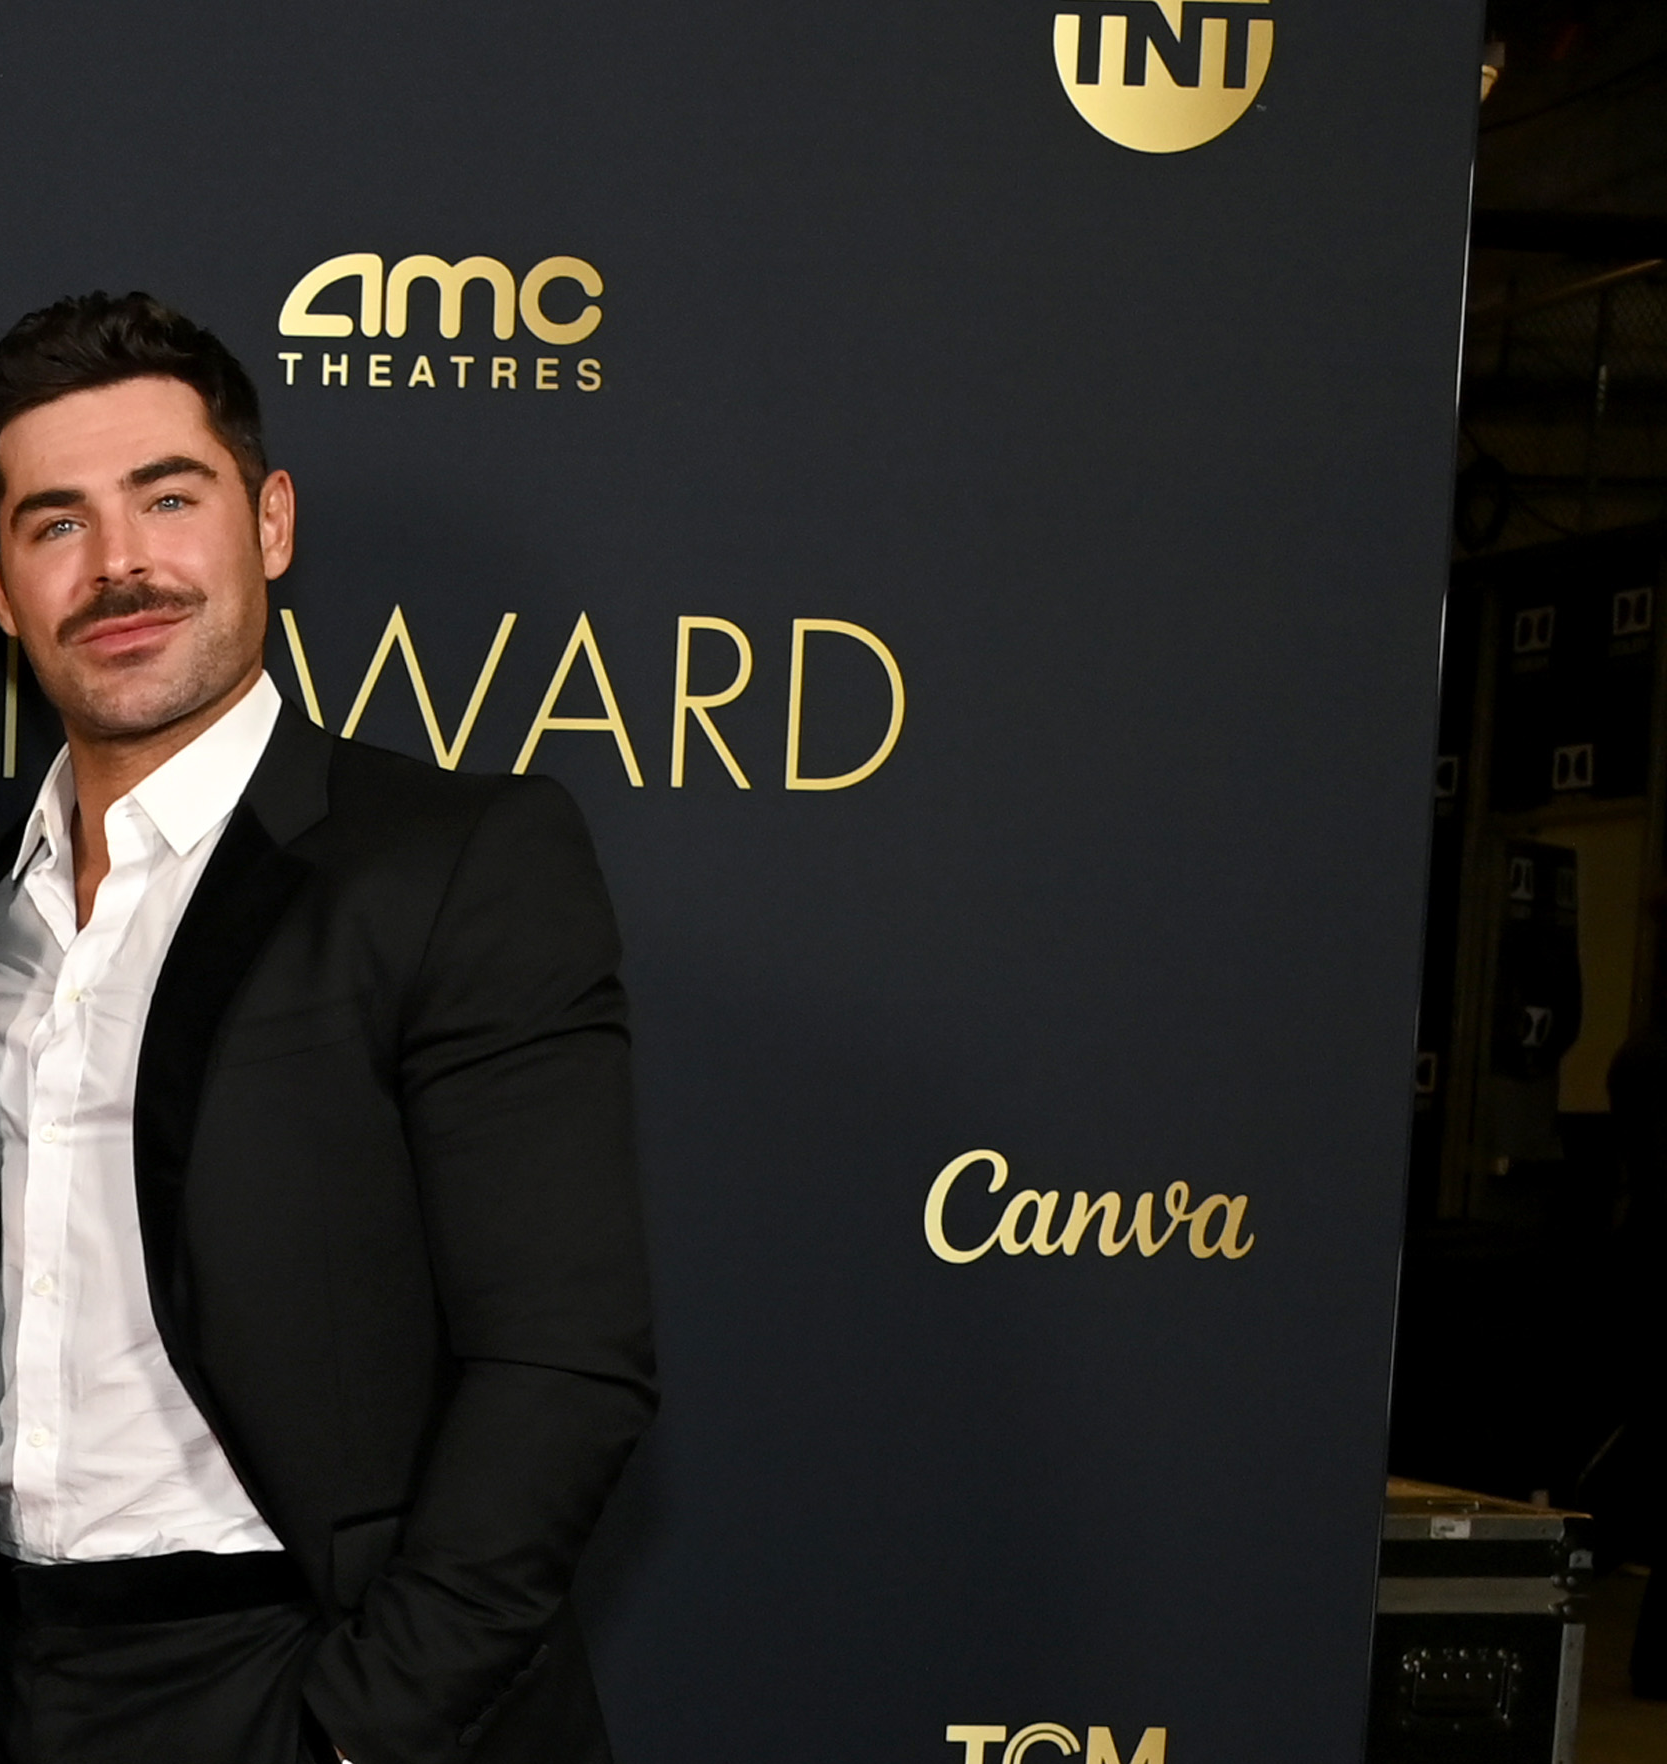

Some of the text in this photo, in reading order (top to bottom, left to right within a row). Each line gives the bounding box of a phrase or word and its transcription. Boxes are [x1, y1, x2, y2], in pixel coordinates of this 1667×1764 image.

[1053, 0, 1276, 90] TNT
[278, 253, 604, 345] amc
[277, 352, 601, 392] THEATRES
[279, 604, 906, 793] WARD
[923, 1149, 1255, 1264] Canva
